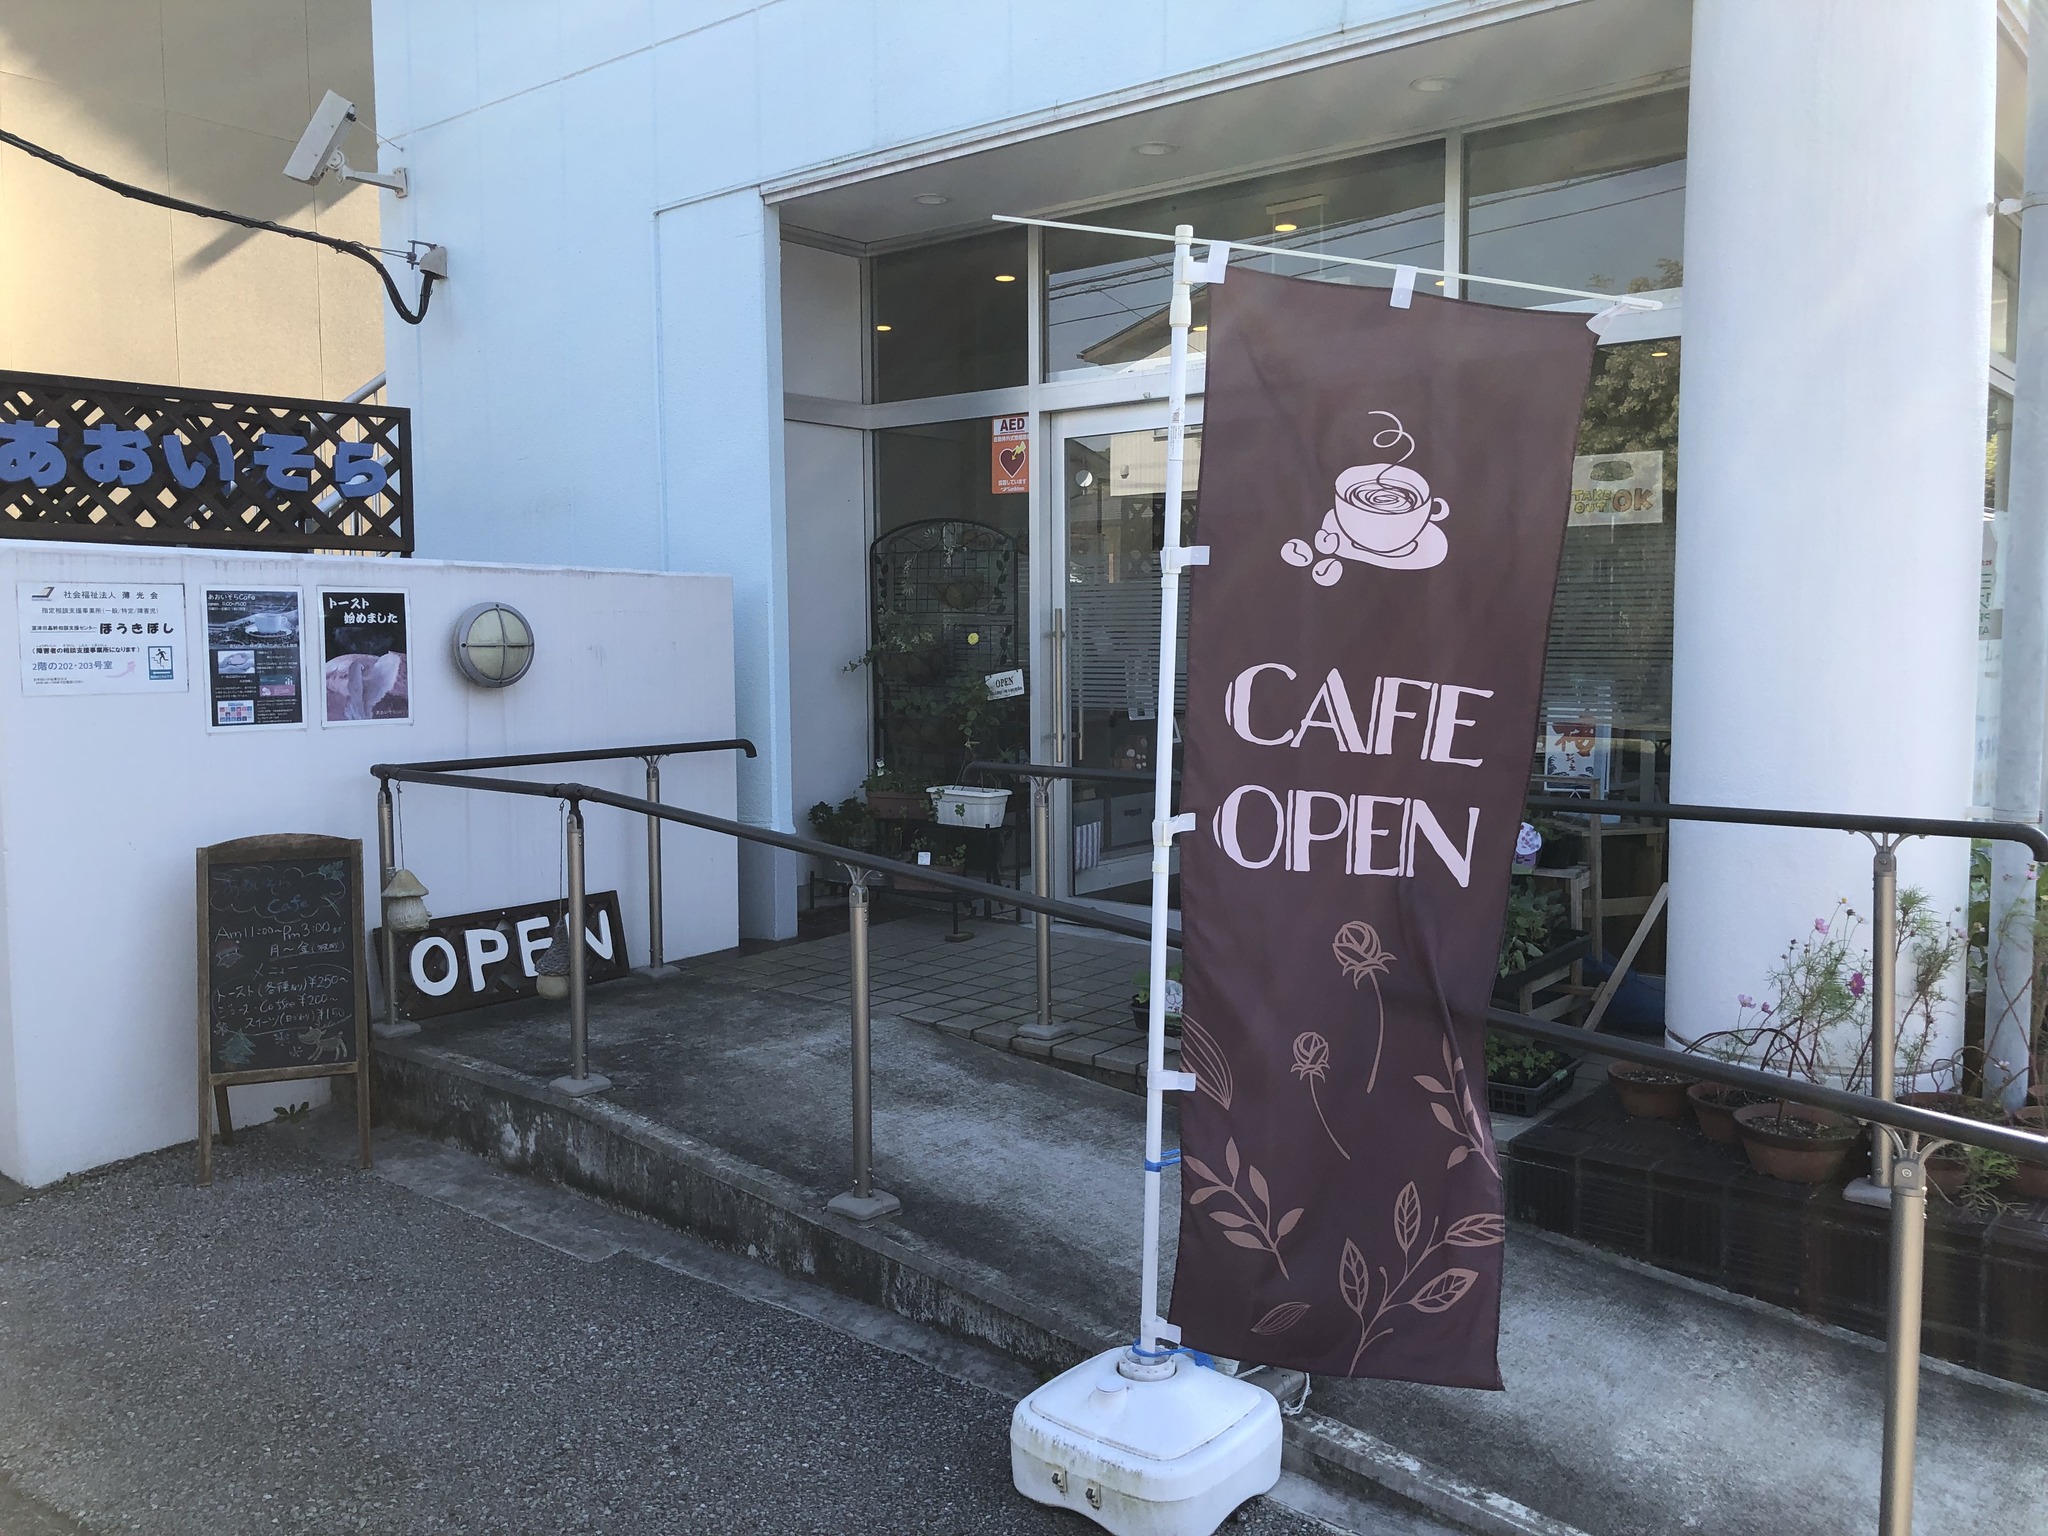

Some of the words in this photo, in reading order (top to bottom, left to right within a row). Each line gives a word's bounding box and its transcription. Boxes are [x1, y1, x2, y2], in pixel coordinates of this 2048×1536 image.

[1000, 418, 1025, 431] AED
[0, 420, 388, 497] あおいそら
[1571, 488, 1612, 501] TAKE
[1612, 487, 1653, 513] OK
[1573, 500, 1607, 514] OUT
[63, 590, 117, 599] 社会福祉法人
[328, 596, 370, 609] トースト
[343, 611, 398, 624] 始めました
[32, 660, 113, 671] 2階の202・203号室
[995, 676, 1014, 688] OPEN
[1224, 662, 1495, 767] CAFE
[1212, 784, 1480, 888] OPEN
[267, 894, 309, 914] Cafe
[409, 909, 614, 997] OPEN
[253, 963, 298, 980] メニュー
